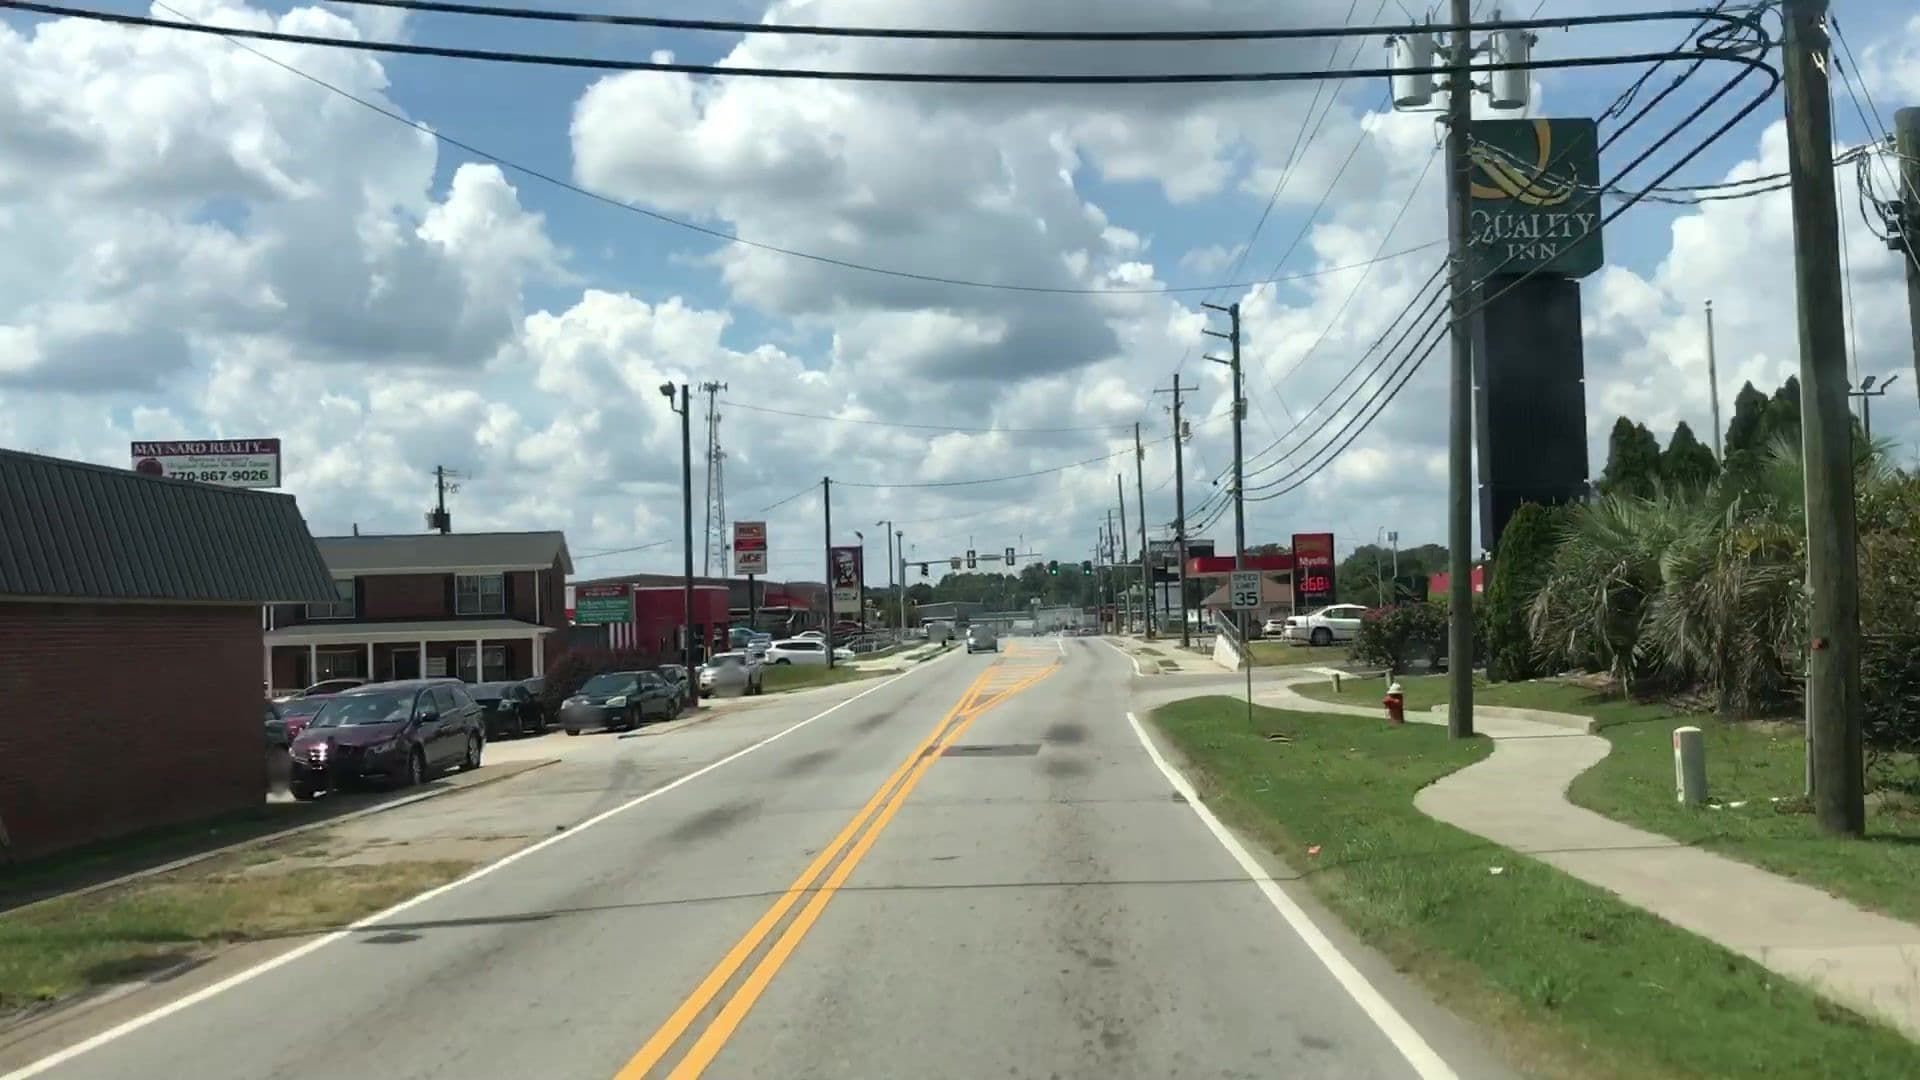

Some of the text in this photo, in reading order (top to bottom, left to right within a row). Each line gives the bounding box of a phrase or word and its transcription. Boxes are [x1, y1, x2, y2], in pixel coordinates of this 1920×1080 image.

[1466, 209, 1595, 247] QUALITY
[1507, 242, 1558, 260] INN
[134, 441, 262, 456] MAYNARD REALTY
[169, 470, 269, 481] 770-867-9026
[1233, 573, 1257, 581] SPEED
[1235, 592, 1258, 606] 35
